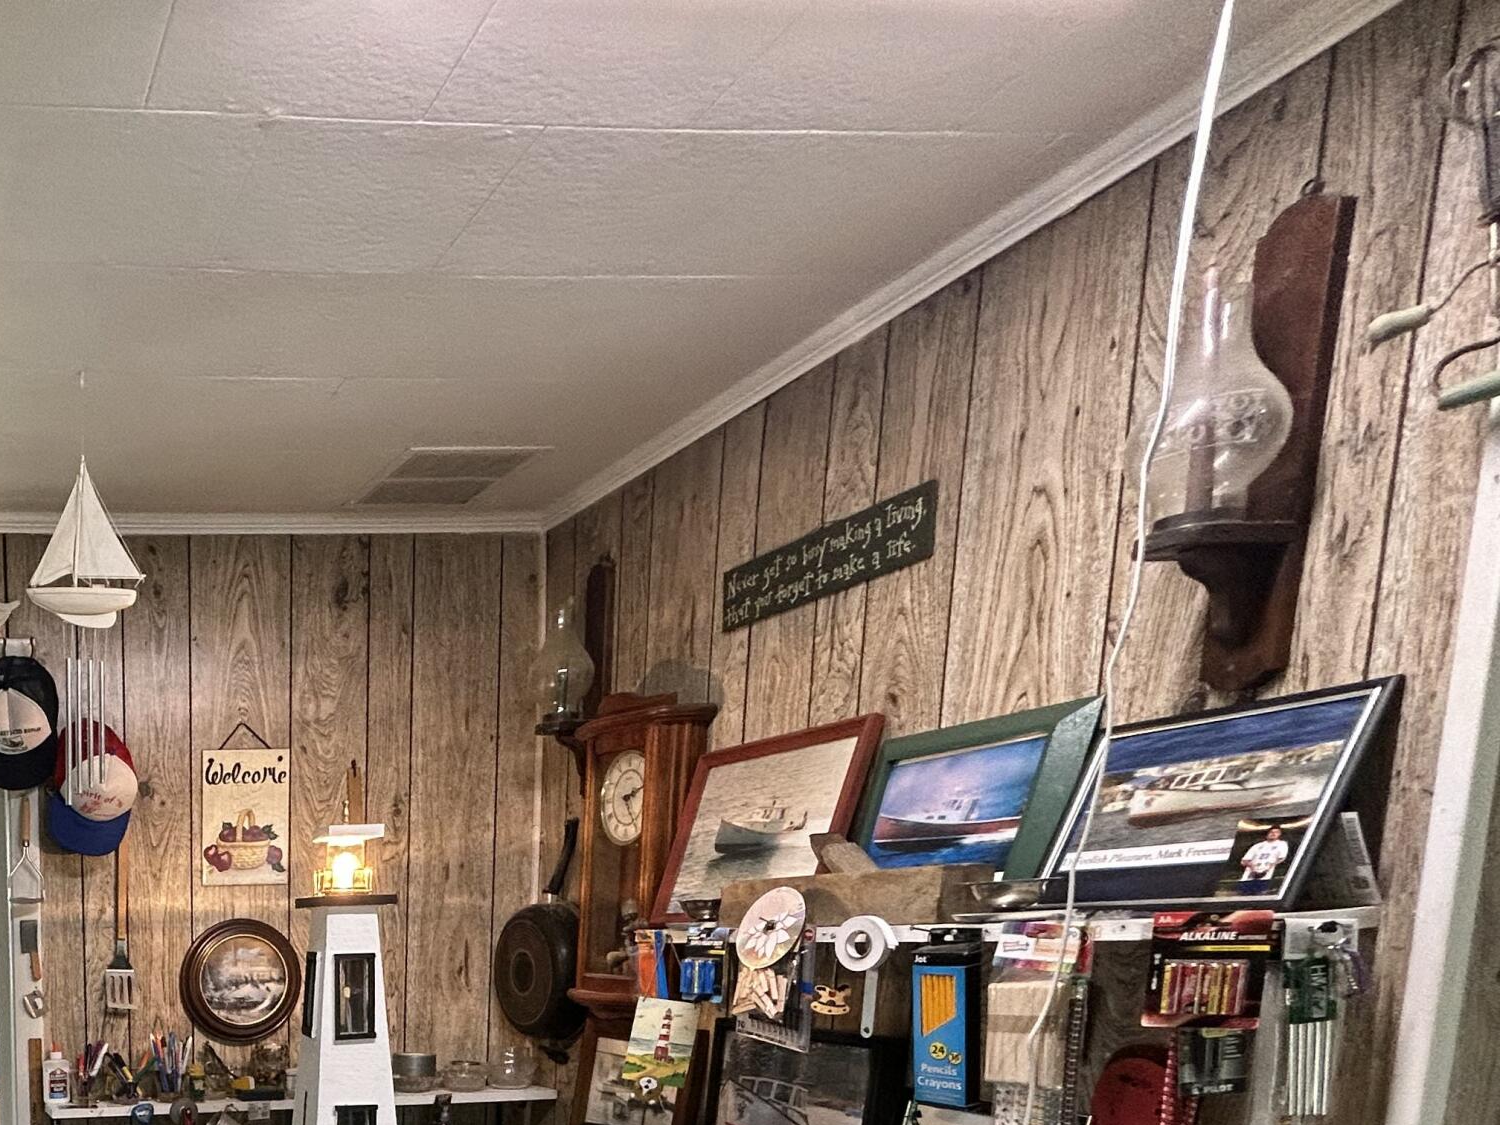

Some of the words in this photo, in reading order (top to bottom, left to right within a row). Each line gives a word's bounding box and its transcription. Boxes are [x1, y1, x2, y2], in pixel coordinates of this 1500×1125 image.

[726, 573, 759, 600] Never
[763, 555, 783, 591] get
[785, 554, 797, 571] so
[830, 521, 871, 549] making
[874, 518, 882, 537] a
[724, 597, 751, 626] that
[755, 591, 773, 618] you
[775, 572, 814, 604] forget
[815, 569, 830, 590] to
[831, 553, 865, 580] make
[872, 551, 881, 570] a
[205, 756, 287, 785] Welcome
[1155, 848, 1182, 859] Mark
[1180, 931, 1238, 941] ALKALINE
[914, 955, 928, 964] Jot
[931, 1044, 945, 1055] 24
[921, 1063, 957, 1076] Pencils
[917, 1076, 962, 1090] Crayons
